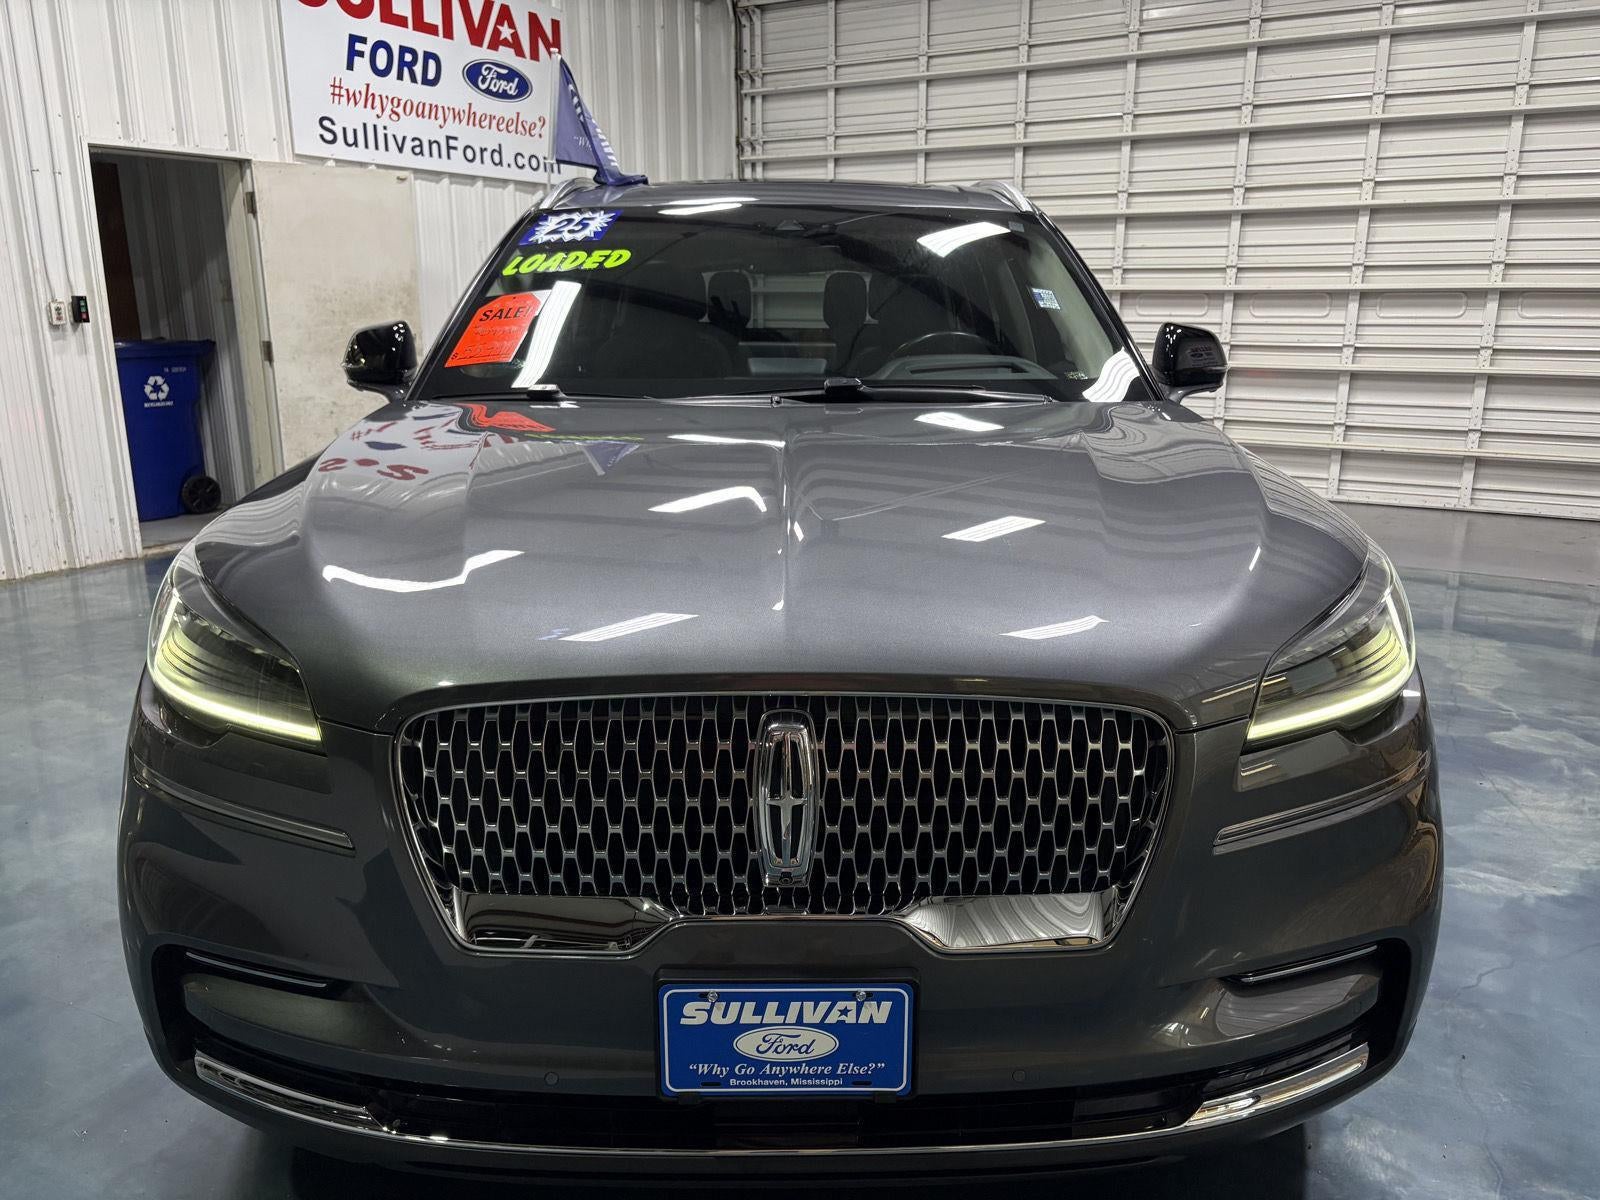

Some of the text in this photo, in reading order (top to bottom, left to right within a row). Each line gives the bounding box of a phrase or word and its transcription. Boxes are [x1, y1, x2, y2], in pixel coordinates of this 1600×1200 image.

[297, 0, 561, 62] LLIVAN
[346, 33, 442, 87] FORD
[477, 63, 520, 96] Ford
[330, 77, 546, 139] #whygoanywhereelse?
[318, 116, 562, 175] SullivanFord.com
[502, 249, 632, 276] LOADED
[479, 305, 532, 322] SALE!
[680, 1001, 893, 1025] SULLIVAN
[755, 1032, 816, 1055] Ford
[729, 1077, 843, 1087] Brookhaven, Mississippi
[734, 1063, 756, 1076] Go
[760, 1063, 832, 1077] Anywhere
